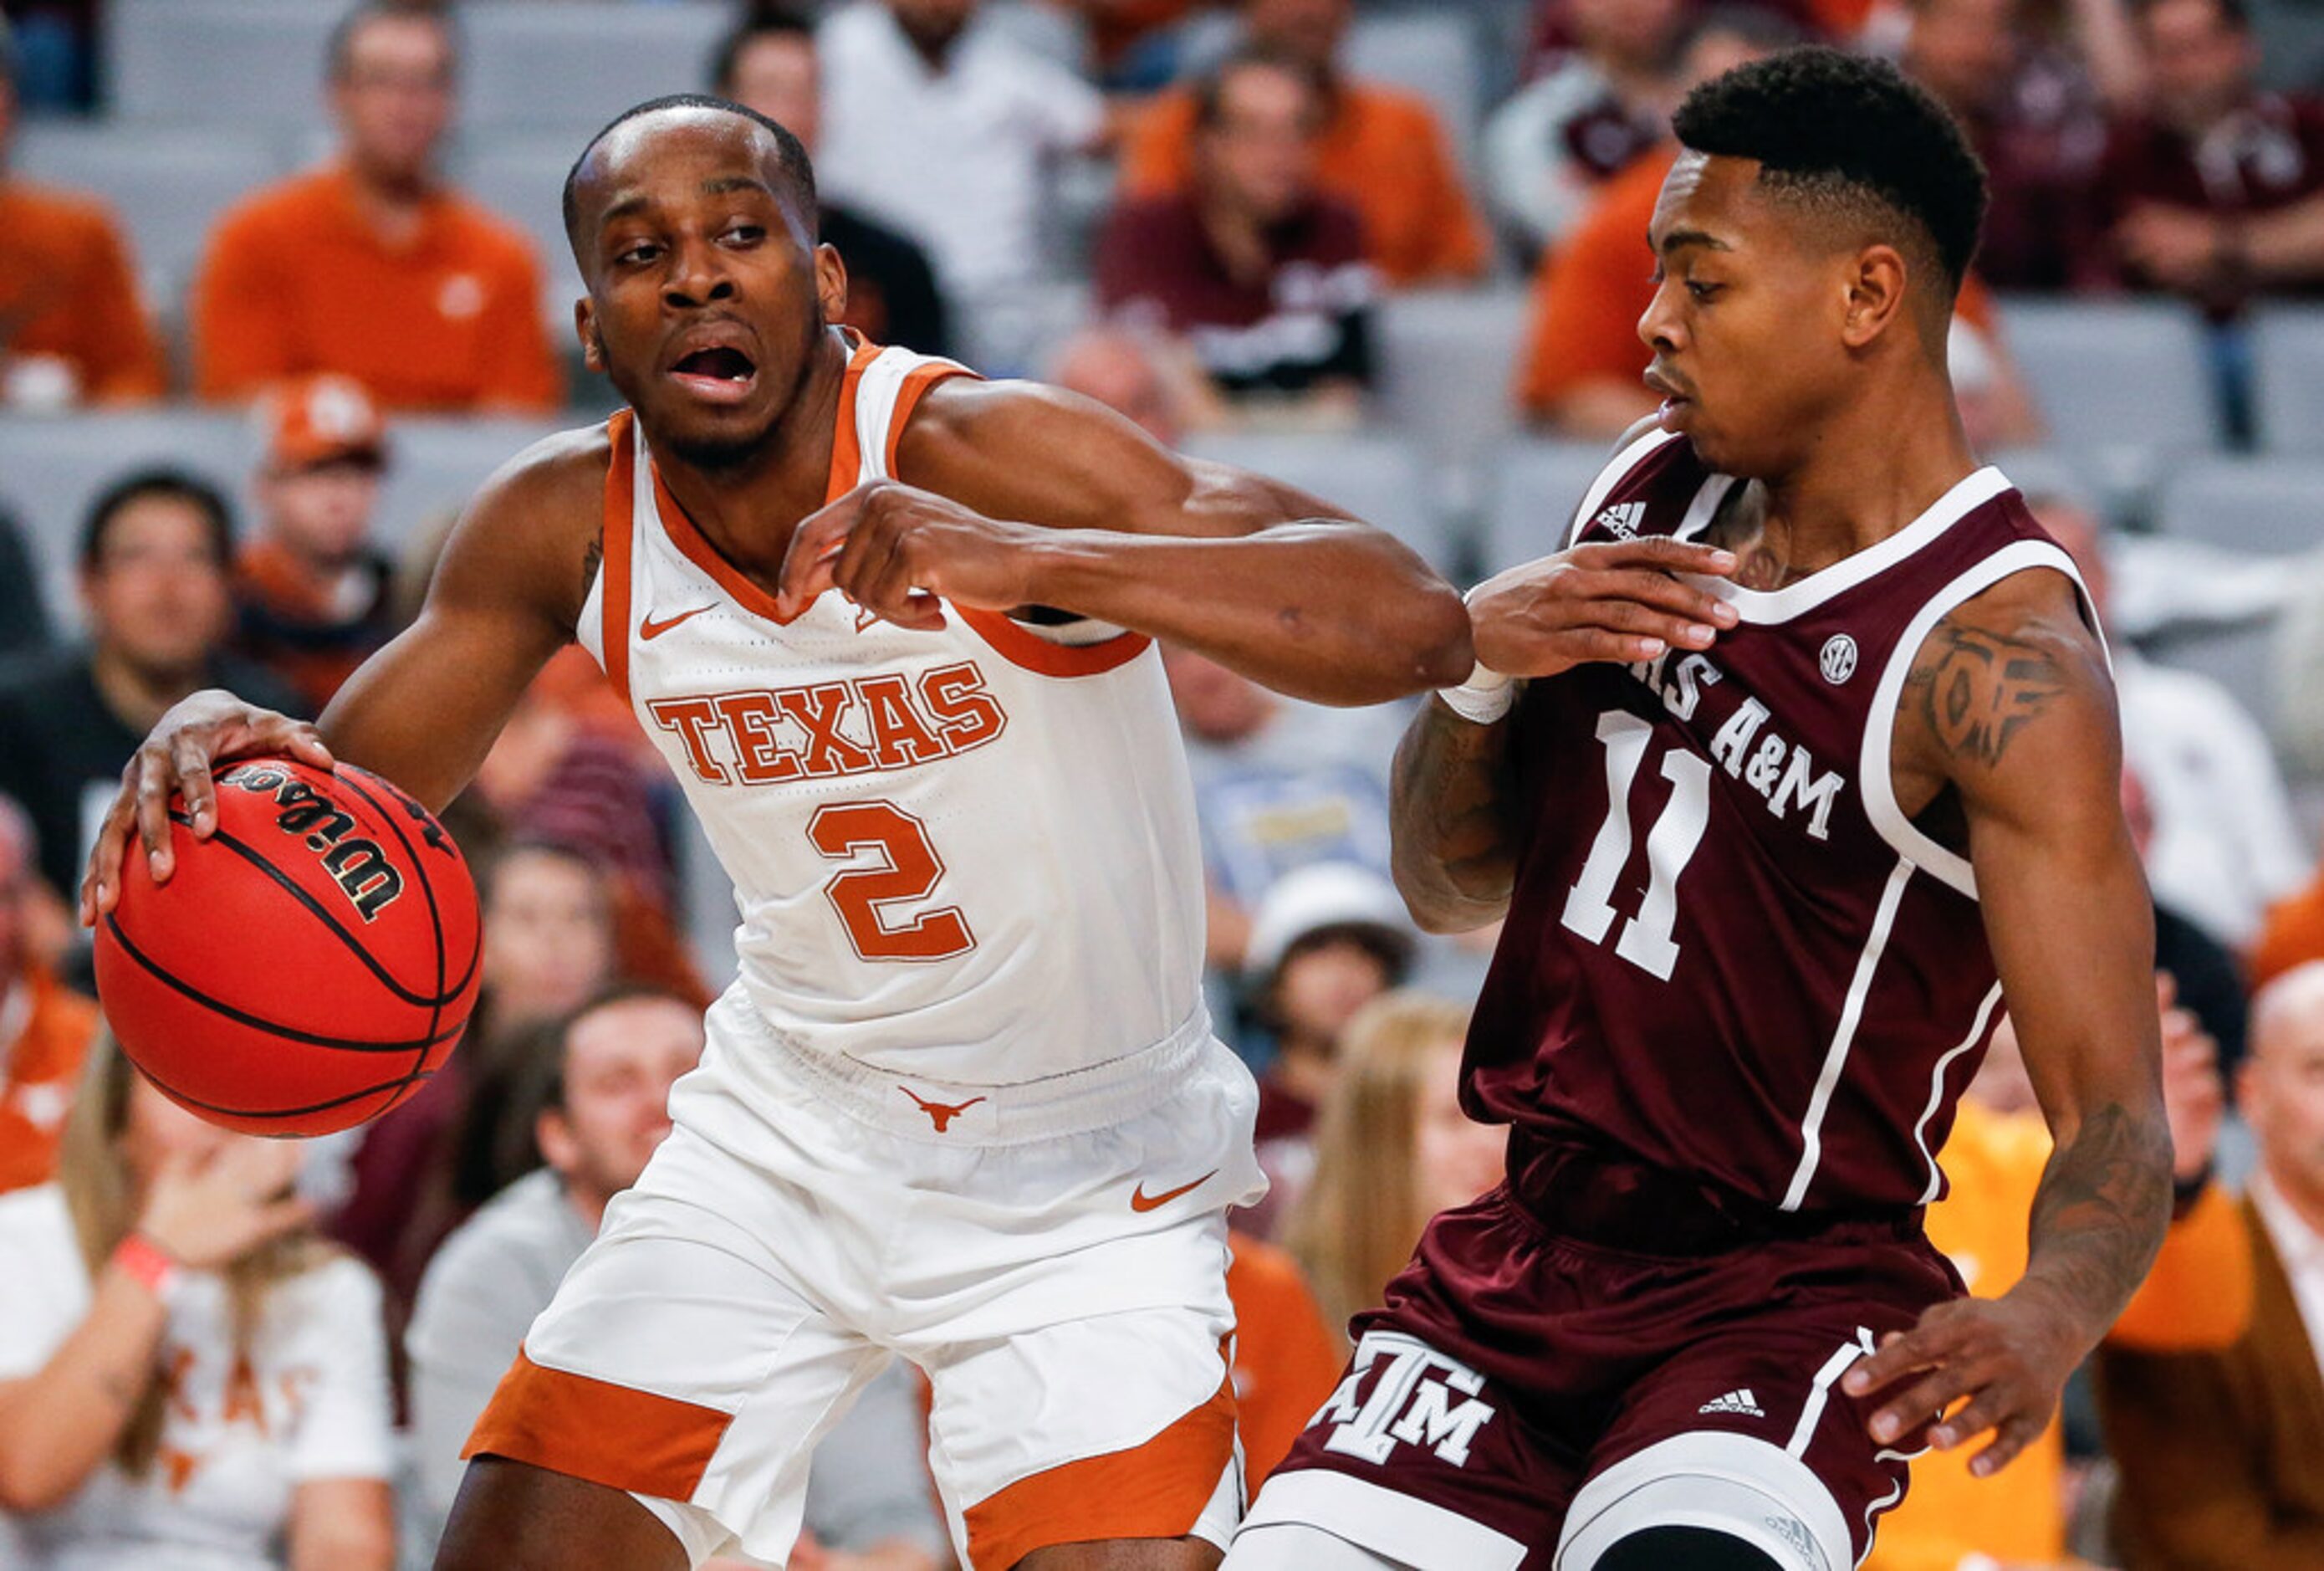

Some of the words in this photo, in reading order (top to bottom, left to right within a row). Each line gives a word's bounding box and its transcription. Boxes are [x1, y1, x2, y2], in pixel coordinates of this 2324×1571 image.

[646, 659, 1009, 786] TEXAS
[1710, 696, 1846, 841] A&M
[805, 799, 978, 963] 2
[1560, 709, 1713, 982] 11
